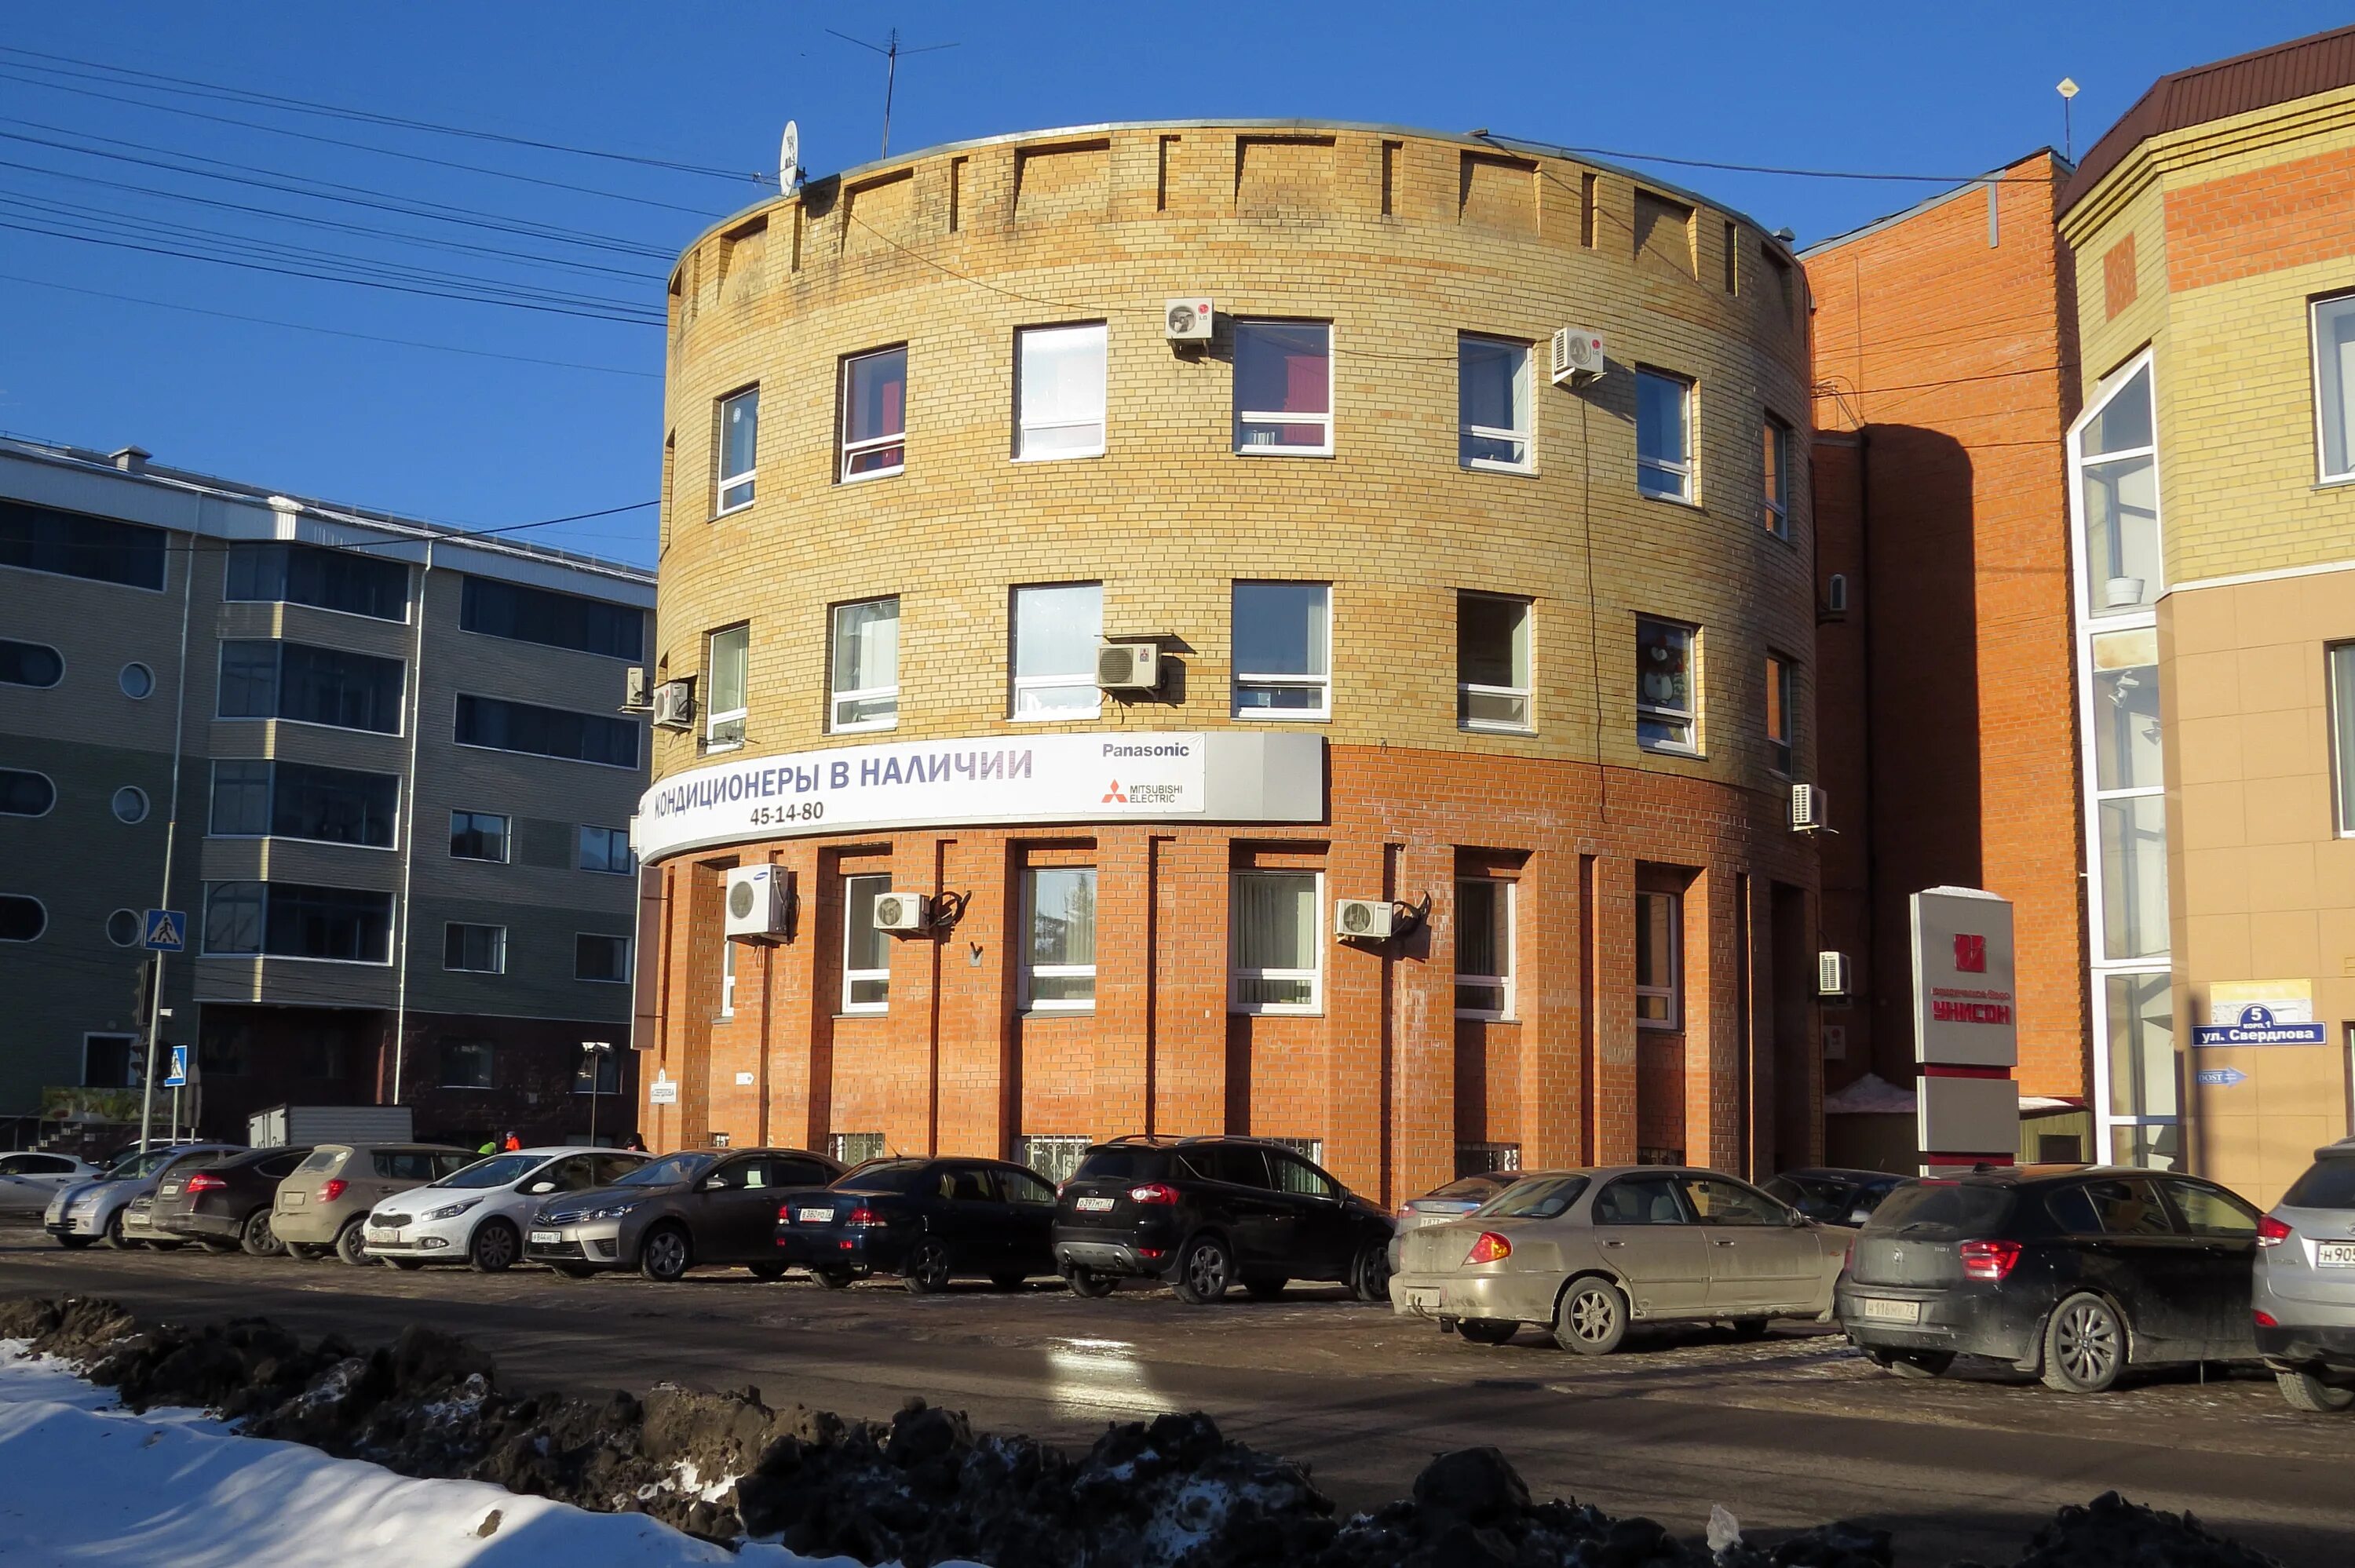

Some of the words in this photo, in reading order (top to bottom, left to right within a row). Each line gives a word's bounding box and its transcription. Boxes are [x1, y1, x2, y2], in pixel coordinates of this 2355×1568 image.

[1103, 742, 1189, 757] Panasonic
[655, 764, 819, 820] КОНДИЦИОНЕРЫ
[830, 761, 849, 789] В
[860, 749, 1032, 787] НАЛИЧИИ
[1130, 785, 1183, 794] MITSUBISHI
[1130, 794, 1176, 803] ELECTRIC
[750, 801, 824, 826] 45-14-80
[1932, 1001, 2010, 1024] УНИСОН
[2251, 1008, 2262, 1021] 5
[2265, 1020, 2271, 1029] 1
[2201, 1032, 2225, 1044] ул.
[2229, 1029, 2315, 1043] Свердлова
